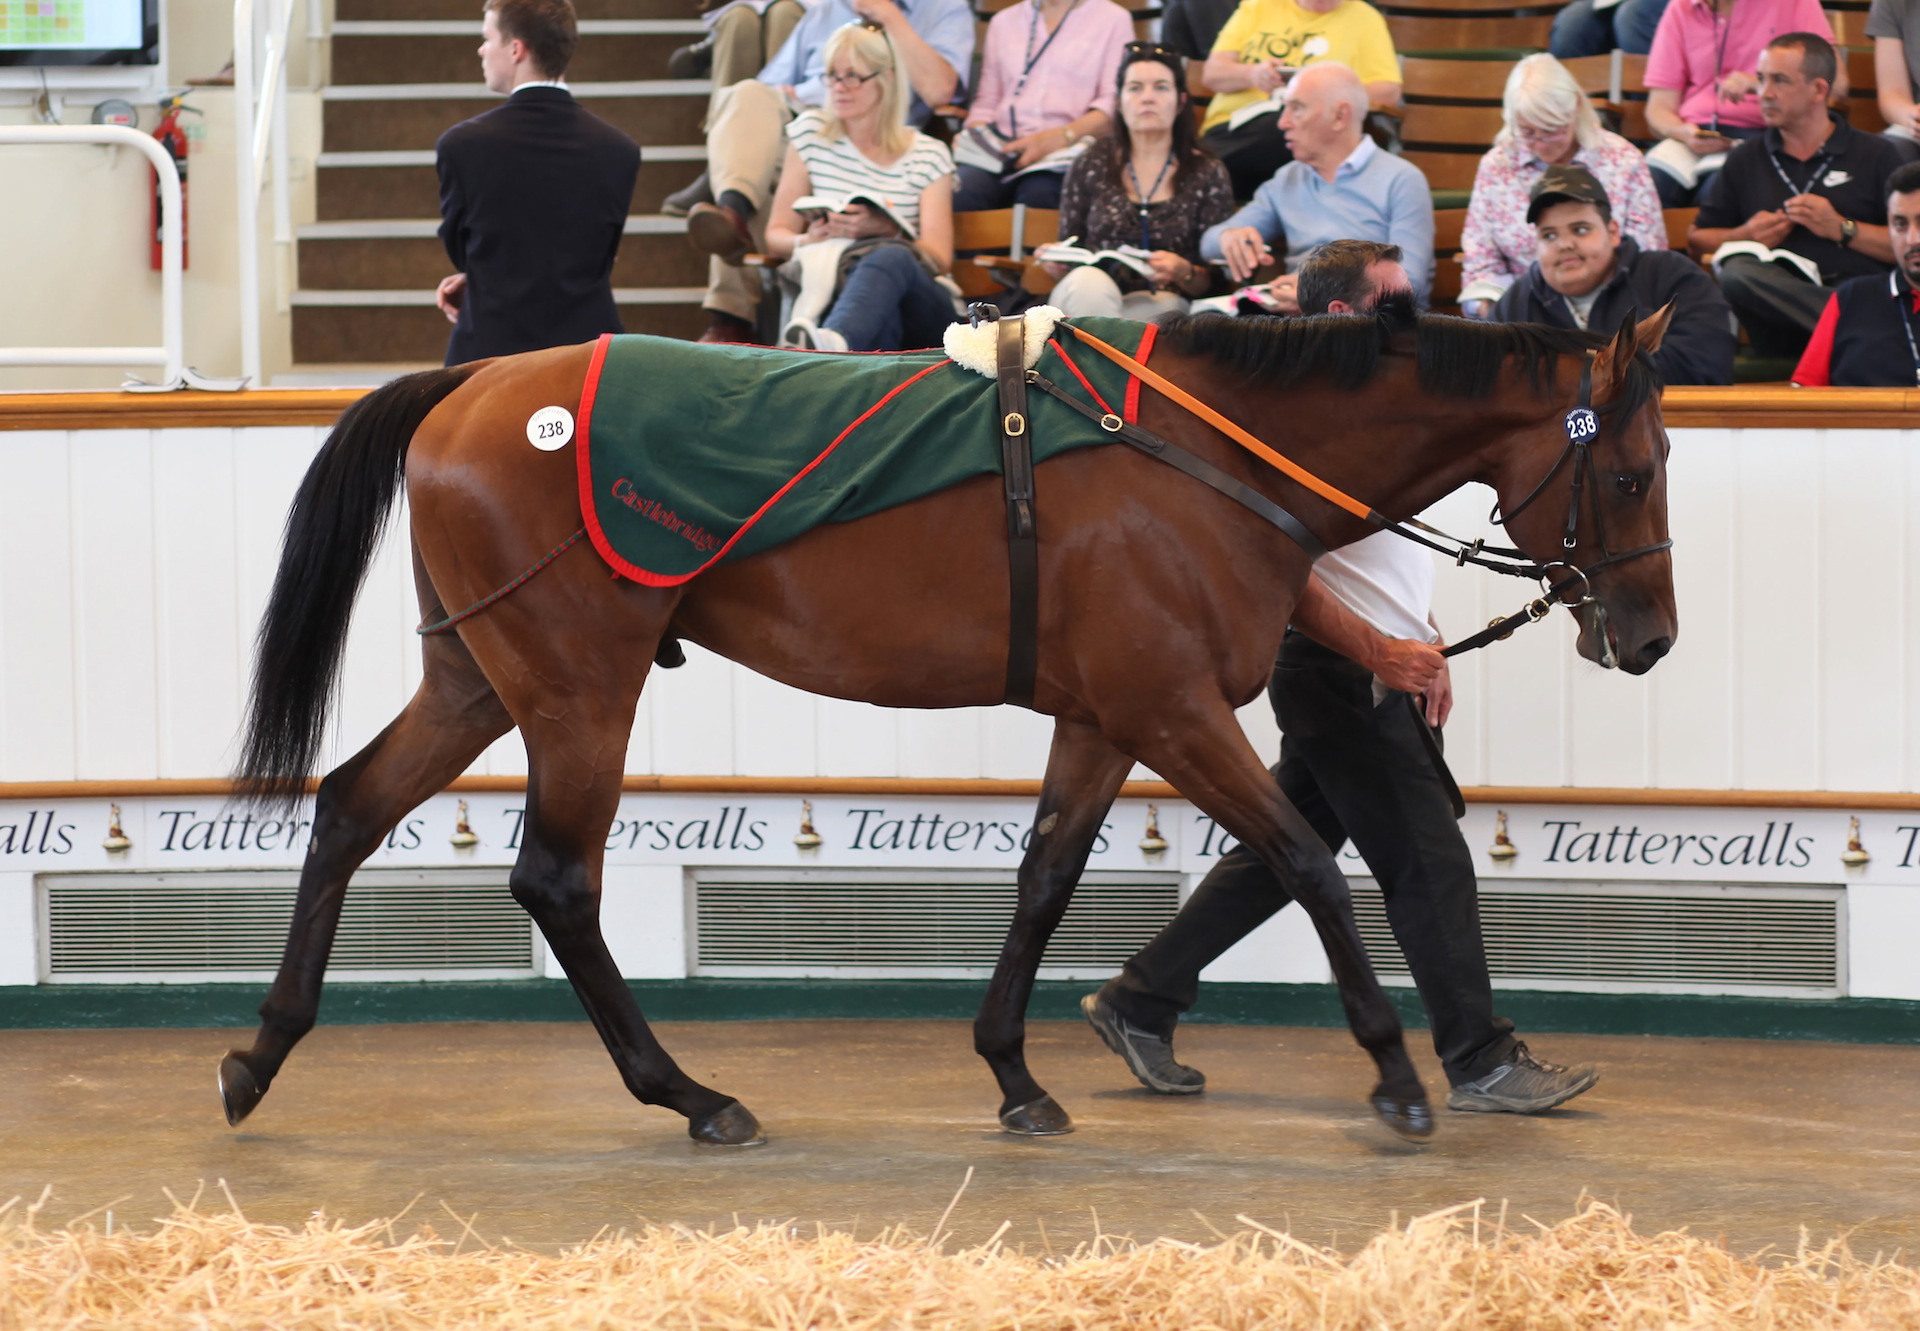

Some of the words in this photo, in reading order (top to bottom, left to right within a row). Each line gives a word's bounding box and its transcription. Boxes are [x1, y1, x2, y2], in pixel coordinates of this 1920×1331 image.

[538, 420, 564, 439] 238
[1567, 415, 1597, 439] 238
[159, 810, 425, 851] Tatterls
[503, 806, 769, 851] Tersalls
[847, 808, 1113, 854] Tatterss
[1543, 821, 1815, 868] Tattersalls
